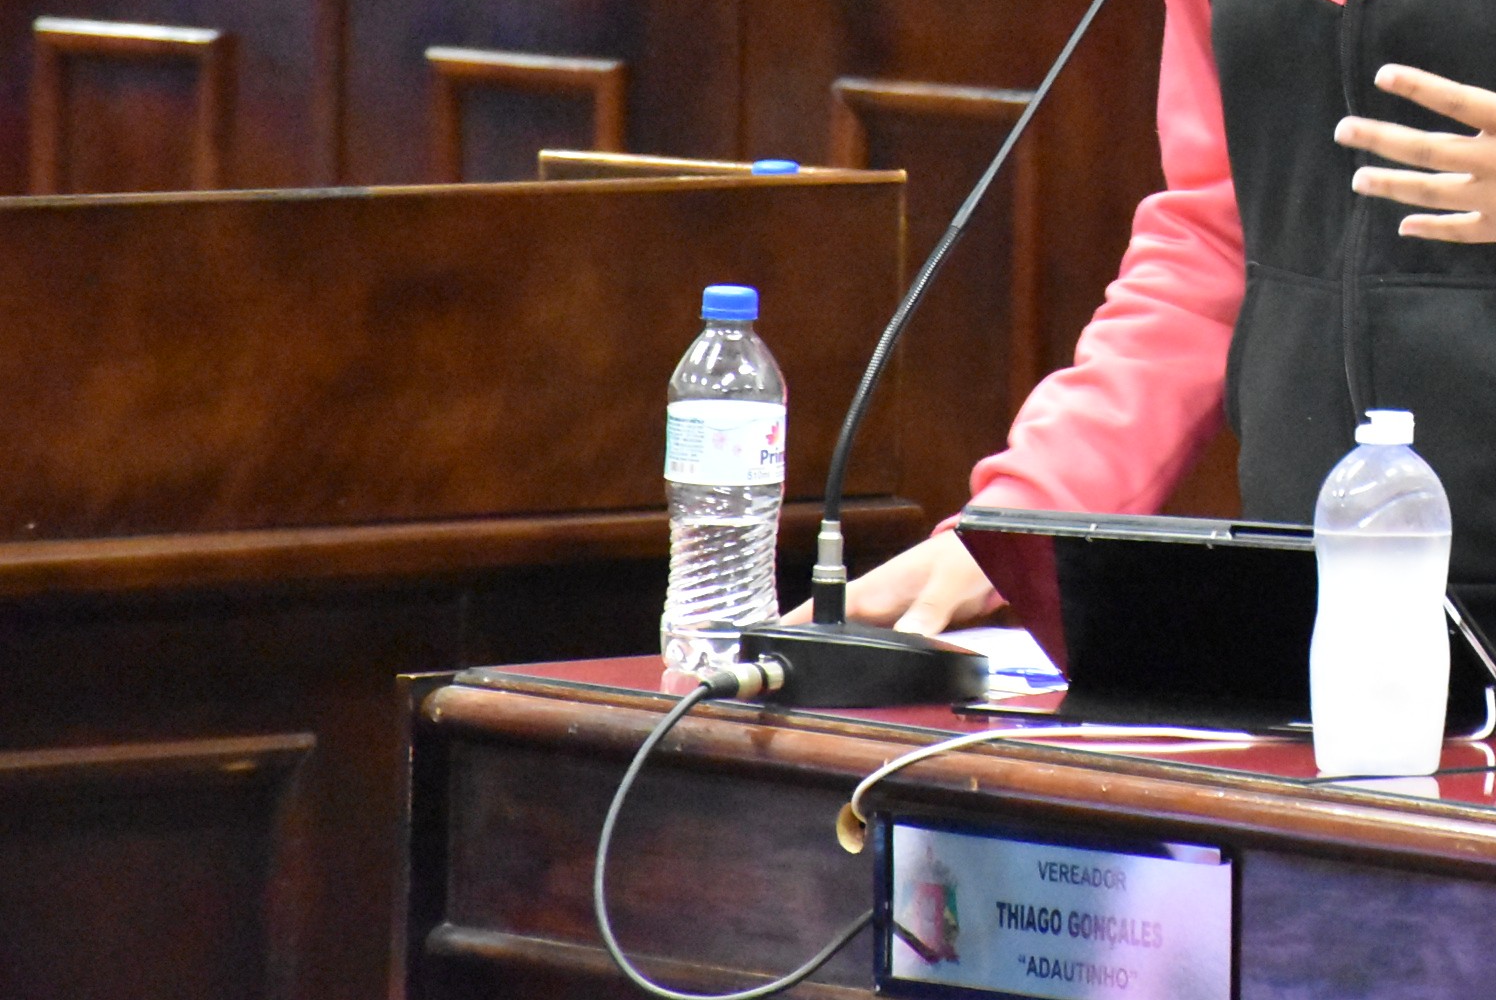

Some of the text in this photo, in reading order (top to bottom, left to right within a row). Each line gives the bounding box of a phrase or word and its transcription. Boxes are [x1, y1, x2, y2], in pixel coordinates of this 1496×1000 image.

[1038, 861, 1127, 890] VEREADOR
[996, 901, 1164, 949] THIAGO GONÇALES
